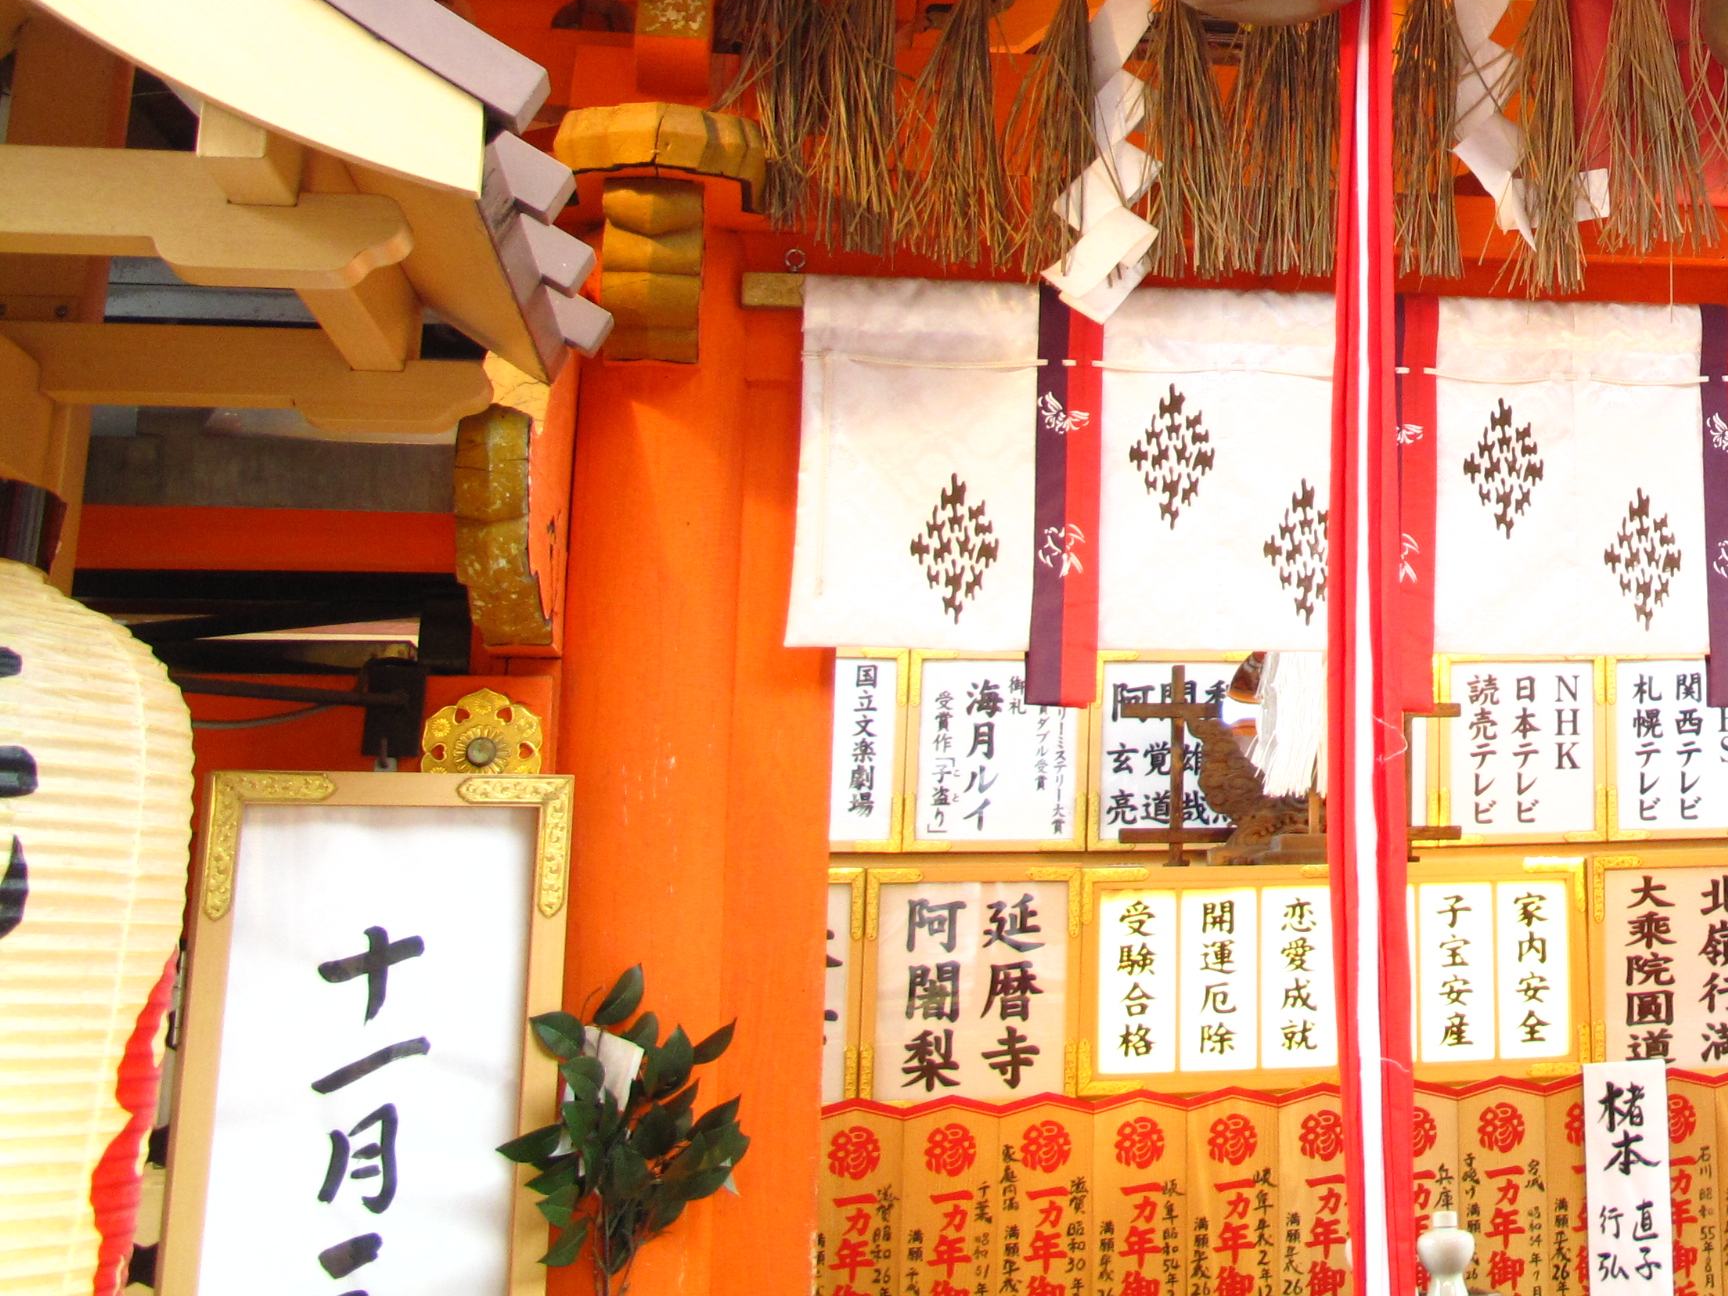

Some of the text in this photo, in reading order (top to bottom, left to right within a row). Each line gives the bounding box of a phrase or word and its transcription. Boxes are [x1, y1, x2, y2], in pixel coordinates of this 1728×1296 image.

[848, 665, 878, 817] 国立文楽劇場
[963, 679, 1004, 831] 海月ルイ
[1009, 676, 1026, 715] 御礼
[1035, 705, 1049, 791] 賞ダブル受賞
[1051, 706, 1068, 834] リーミステリー大賞
[1467, 674, 1500, 824] 読売テレビ
[1512, 676, 1541, 823] 日本テレビ
[1555, 675, 1581, 770] NHK
[1633, 673, 1664, 821] 札幌テレビ
[1675, 672, 1704, 820] 関西テレビ
[1106, 743, 1139, 825] 玄亮
[980, 892, 1045, 1089] 延暦寺
[1117, 900, 1156, 1057] 受験合格
[1200, 900, 1237, 1055] 開運厄除
[1281, 898, 1318, 1050] 恋愛成就
[1436, 895, 1473, 1046] 子宝安産
[1513, 892, 1552, 1043] 家内安全
[1633, 1200, 1662, 1280] 直子
